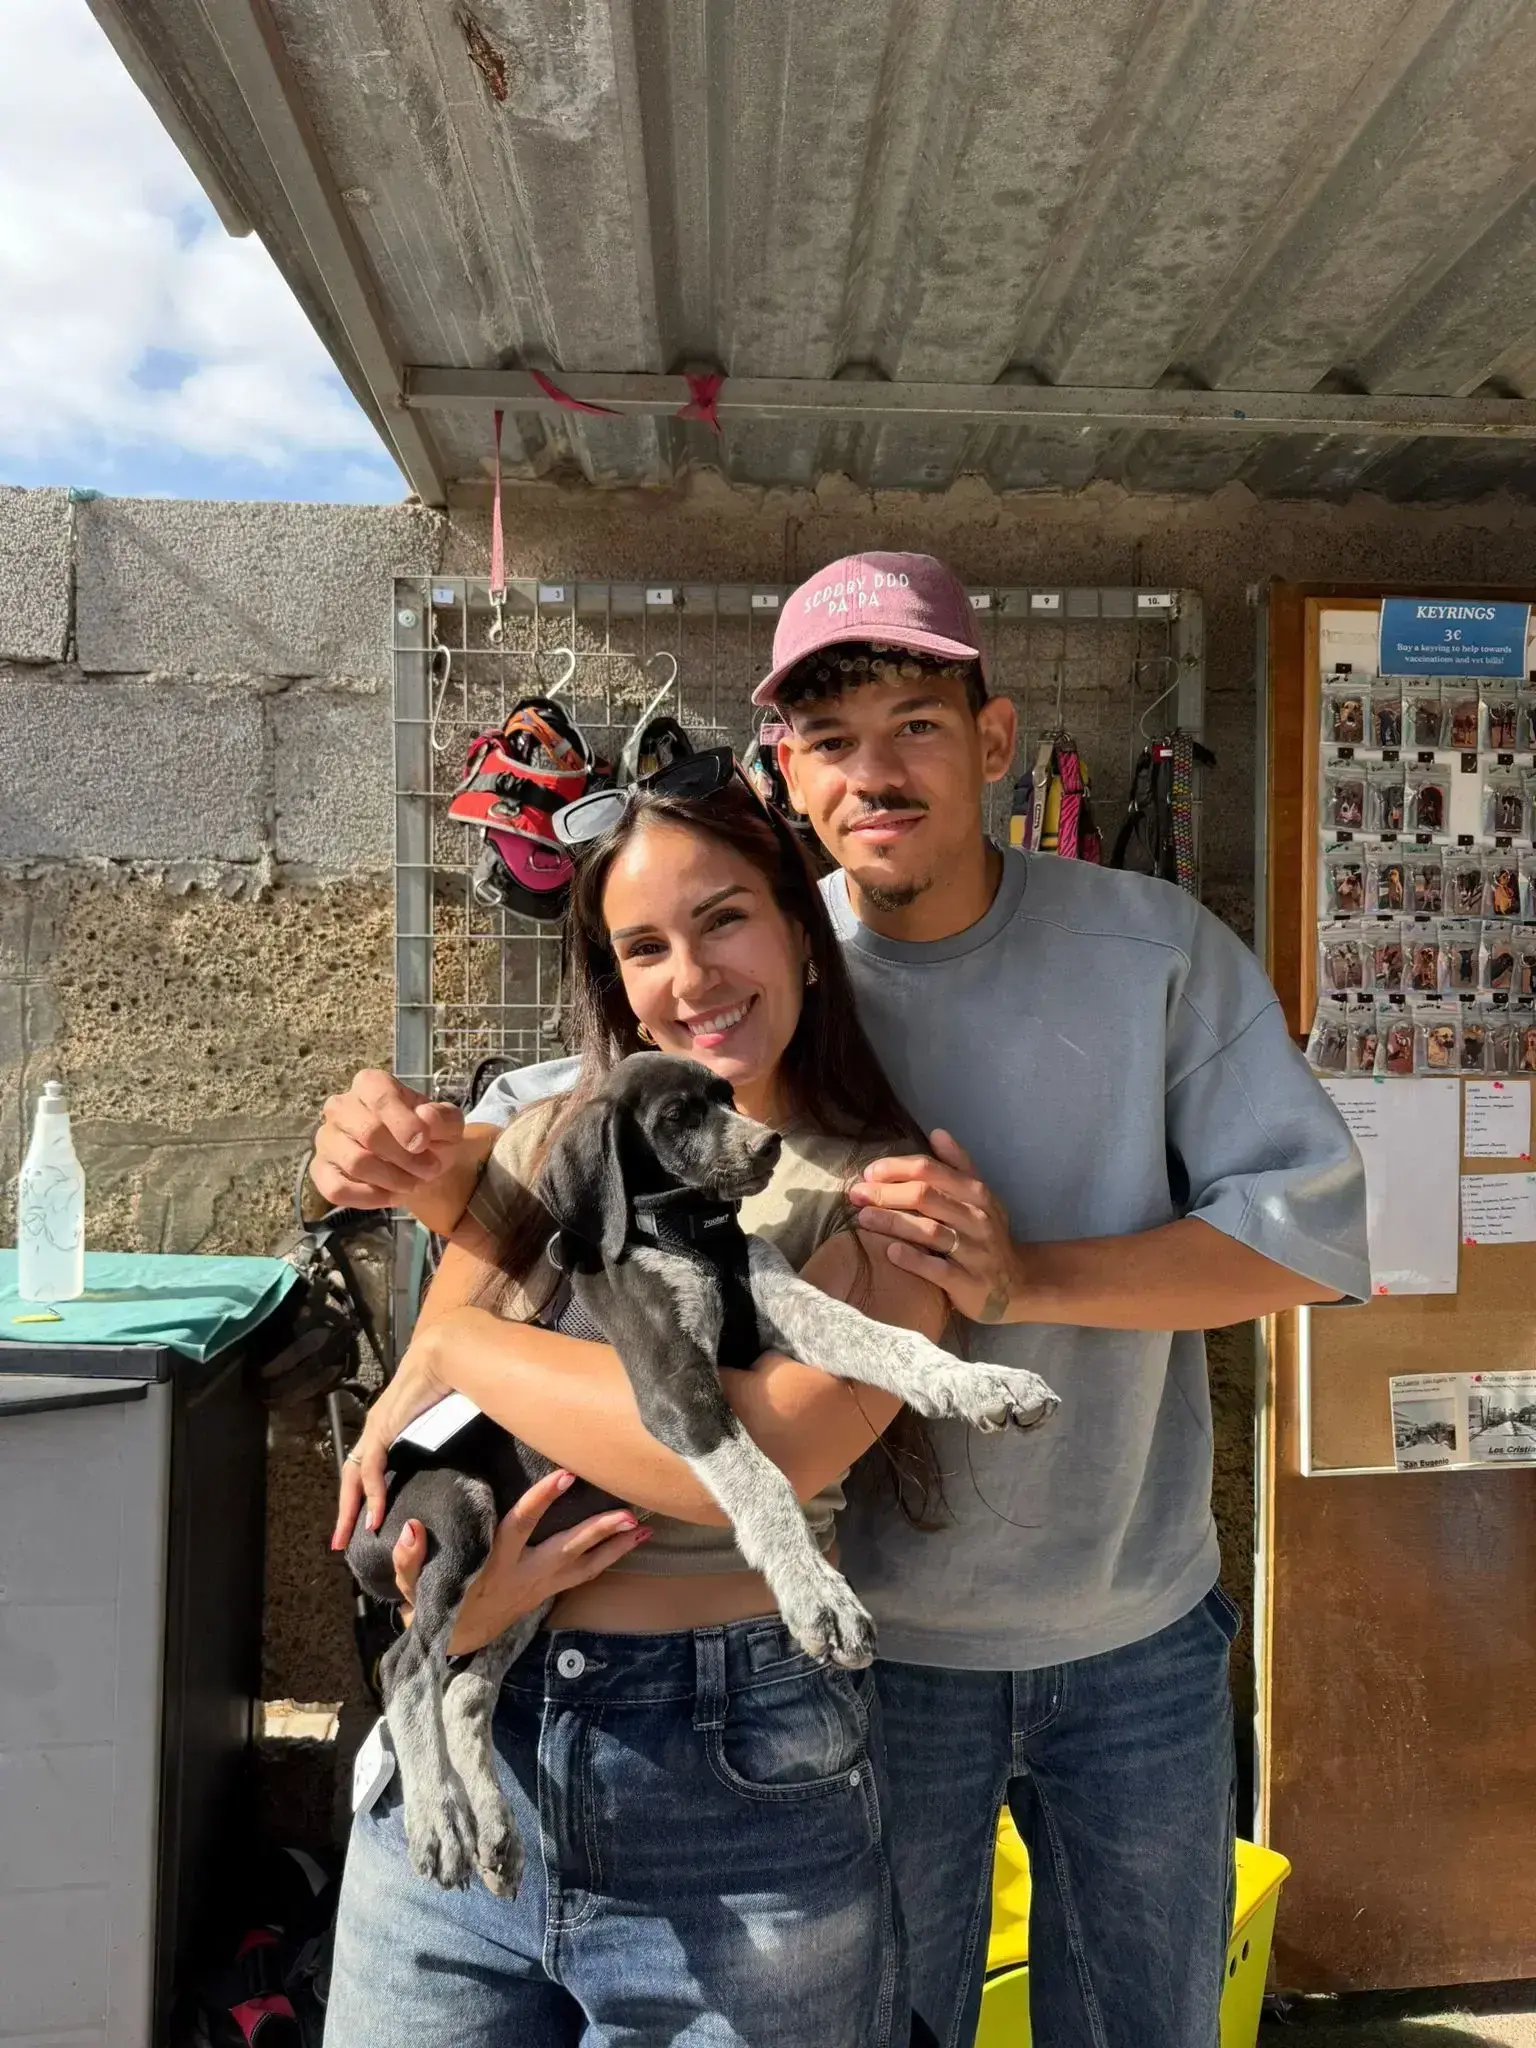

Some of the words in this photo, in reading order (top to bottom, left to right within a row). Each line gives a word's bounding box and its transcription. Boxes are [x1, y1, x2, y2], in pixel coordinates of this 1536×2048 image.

[555, 591, 560, 599] 3
[657, 592, 661, 600] 4
[803, 576, 866, 614] SCOOBY
[874, 573, 909, 588] DOO
[828, 596, 849, 617] PA
[858, 591, 879, 609] PA
[1044, 597, 1050, 606] 9
[1416, 605, 1496, 620] KEYRINGS
[1443, 629, 1462, 642] 3€
[1397, 643, 1414, 652] Buy
[1420, 643, 1451, 653] keyring
[1462, 644, 1479, 654] help
[1480, 645, 1512, 653] towards
[1404, 655, 1454, 663] vaccinations
[1455, 655, 1470, 664] and
[1485, 656, 1505, 665] bills!
[1488, 1446, 1504, 1454] Los
[1403, 1460, 1418, 1469] San
[1420, 1457, 1450, 1468] Eugenio
